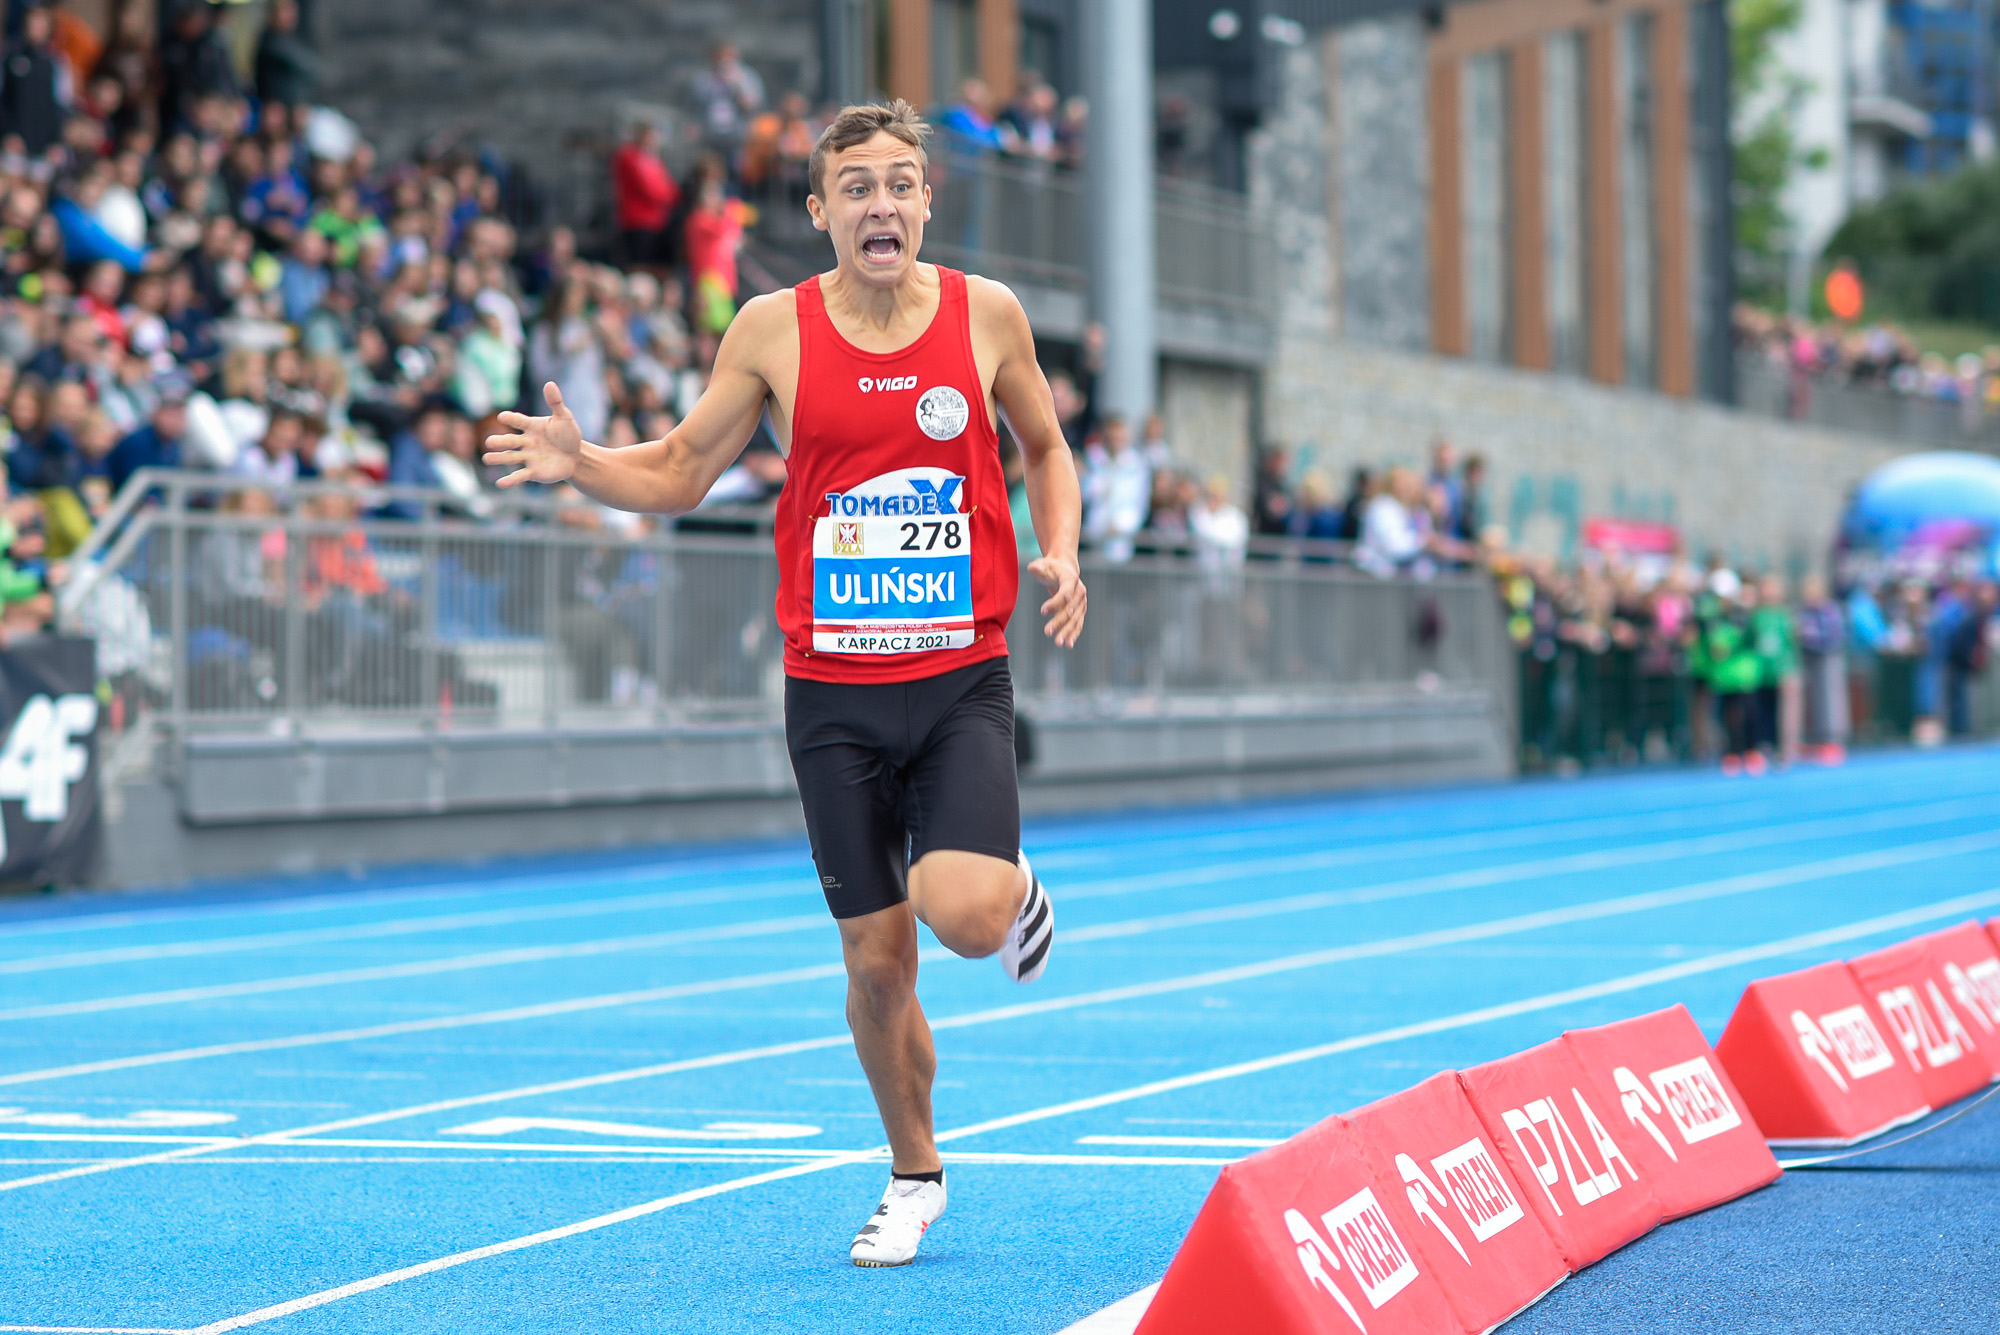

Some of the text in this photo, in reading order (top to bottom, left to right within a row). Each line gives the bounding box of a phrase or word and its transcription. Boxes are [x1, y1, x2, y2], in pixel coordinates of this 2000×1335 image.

[875, 375, 918, 392] VIGO
[826, 475, 966, 516] TOMADEX
[834, 543, 862, 554] PZLA
[900, 520, 962, 551] 278
[829, 566, 955, 605] ULIŃSKI
[837, 635, 950, 651] KARPACZ 2021
[1877, 976, 1976, 1074] PZLA
[1663, 1070, 1731, 1130] ORLEN
[1501, 1087, 1639, 1217] PZLA
[1444, 1152, 1513, 1227] ORLEN
[1336, 1203, 1407, 1290] ORLEN
